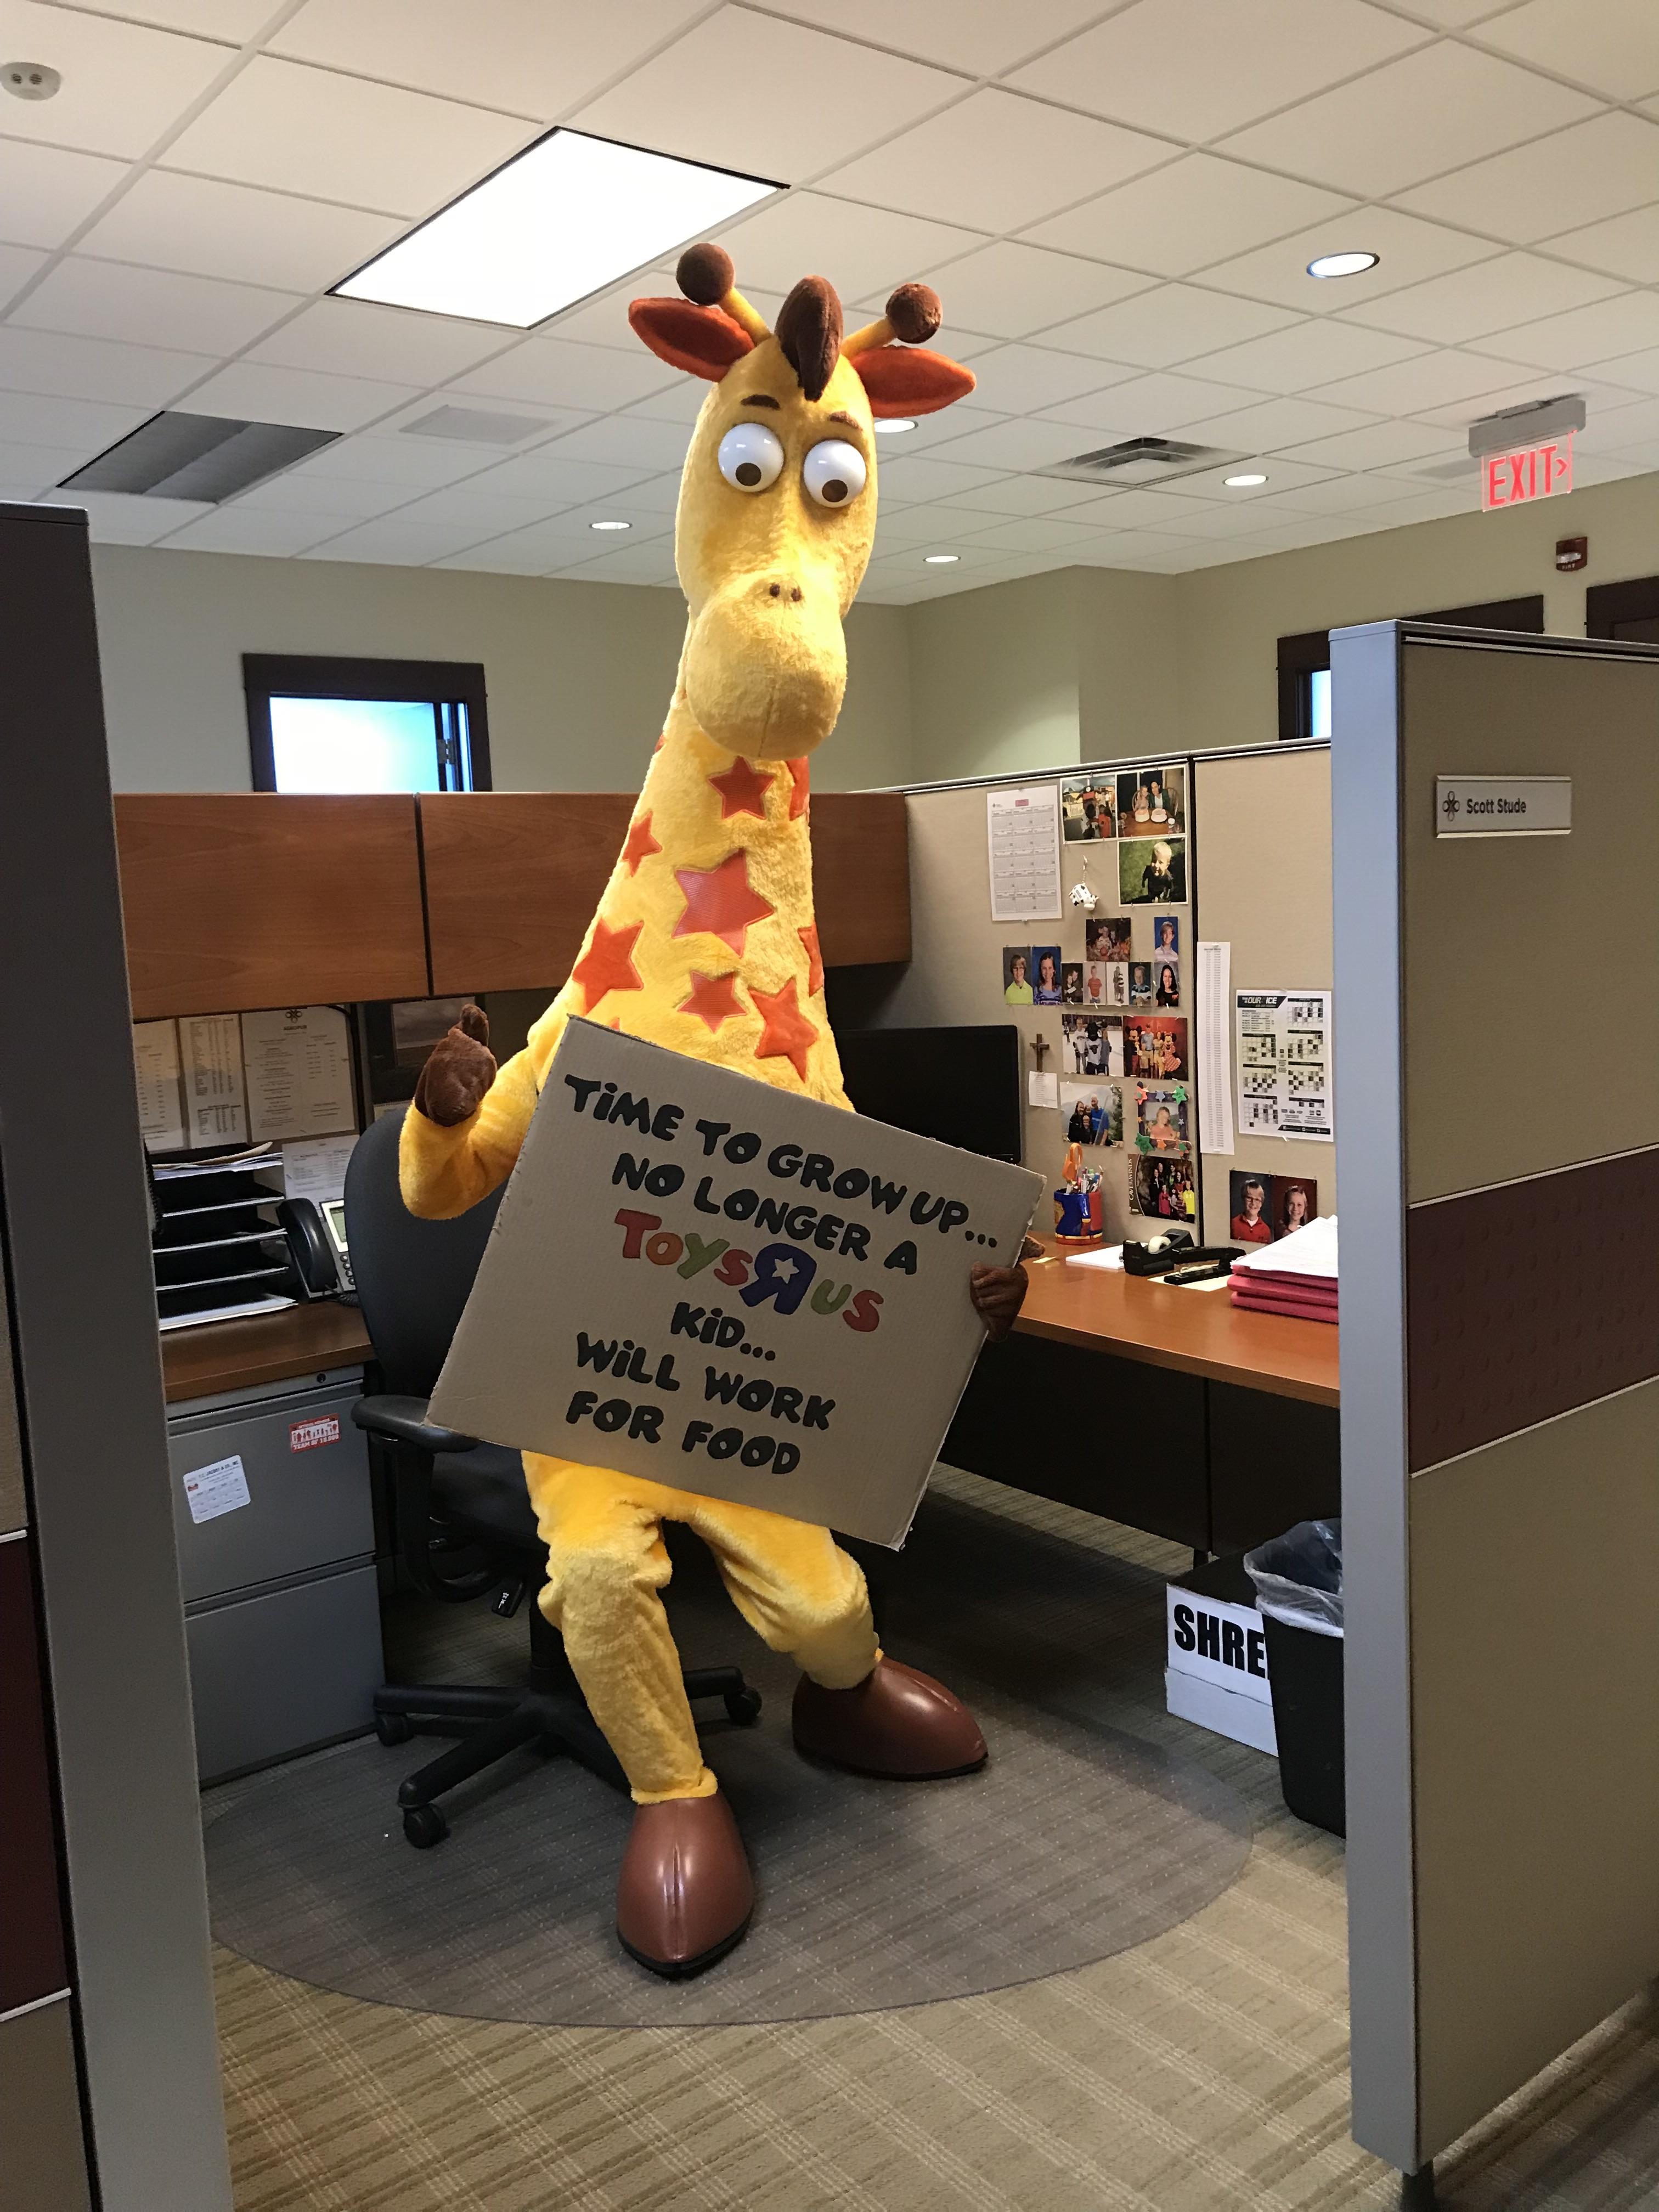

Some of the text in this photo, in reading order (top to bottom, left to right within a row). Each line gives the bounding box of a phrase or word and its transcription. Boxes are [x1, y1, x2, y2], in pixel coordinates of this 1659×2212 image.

[1488, 443, 1557, 507] EXIT
[1466, 798, 1526, 814] Scott Stude
[612, 1153, 917, 1275] NO LONGER A
[696, 1119, 761, 1164] TO
[768, 1144, 907, 1215] GROW
[910, 1192, 997, 1248] UP...
[566, 1391, 800, 1474] FOR FOOD
[704, 1366, 836, 1431] WORK
[1174, 1604, 1266, 1679] SHRE
